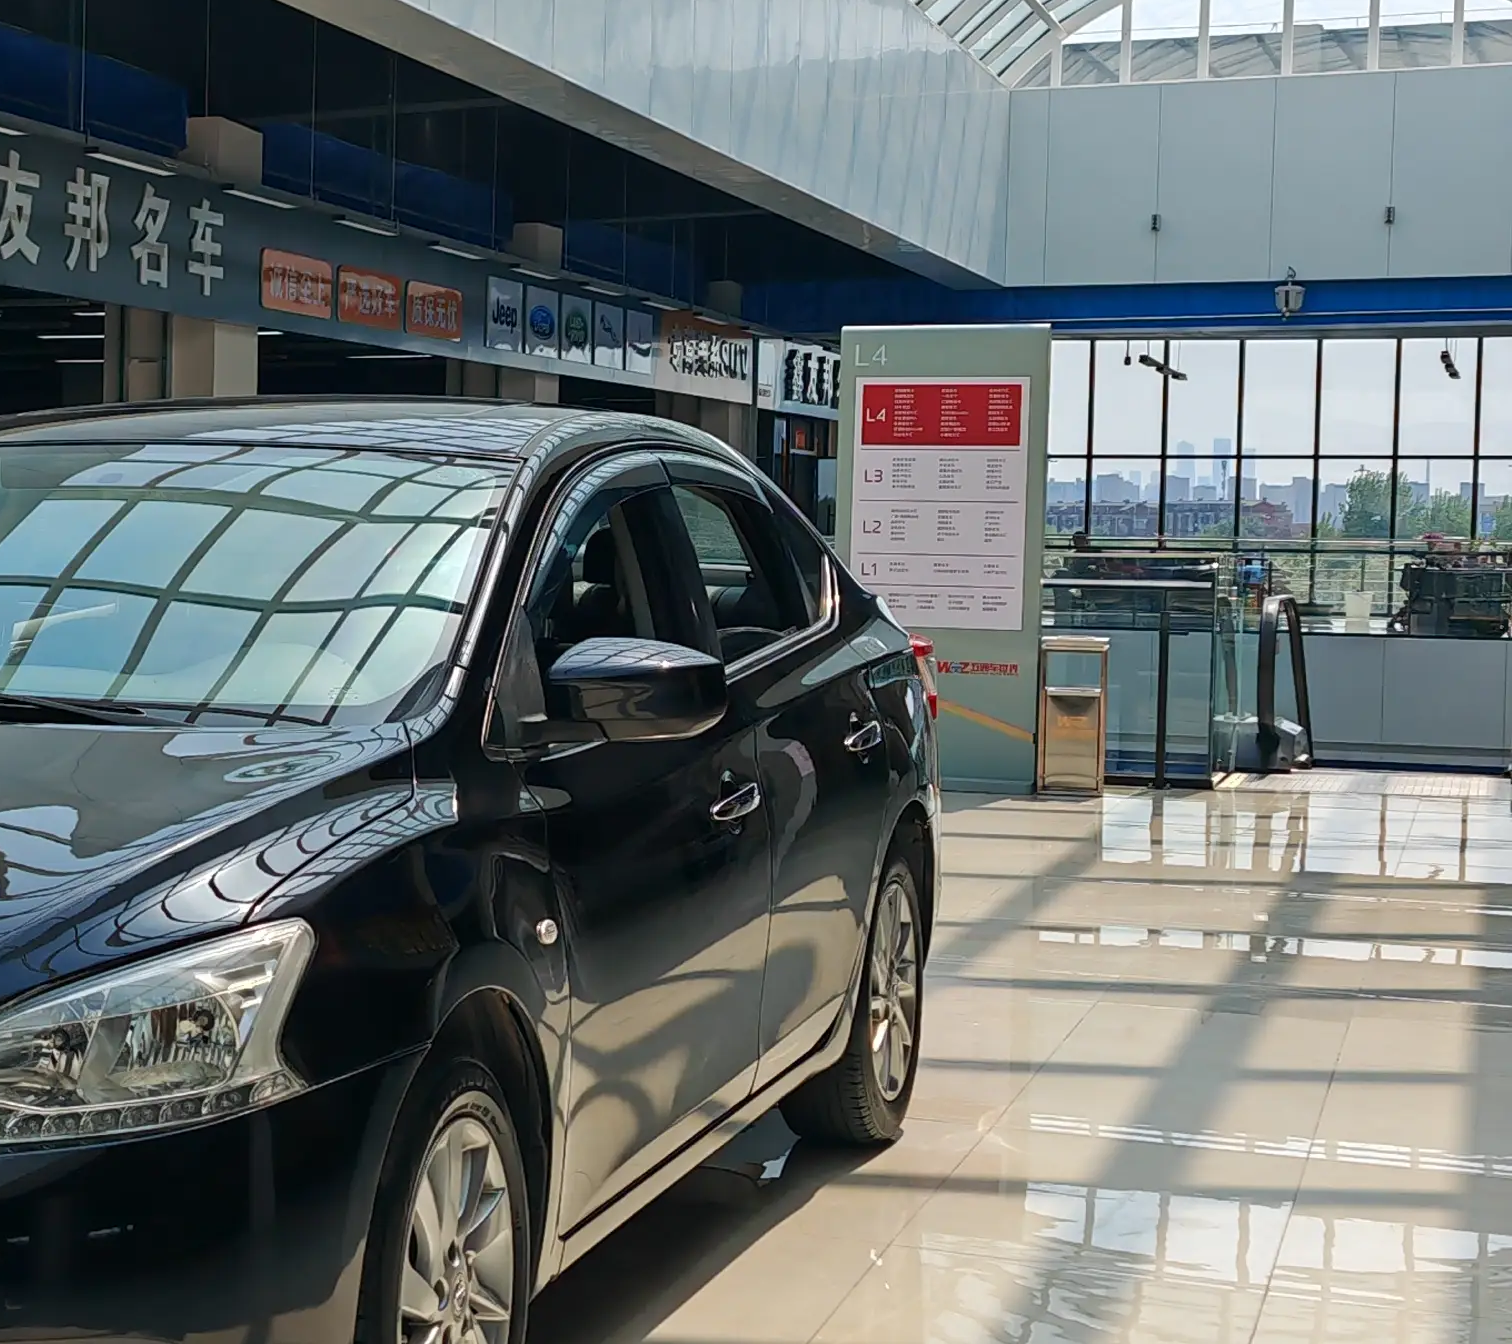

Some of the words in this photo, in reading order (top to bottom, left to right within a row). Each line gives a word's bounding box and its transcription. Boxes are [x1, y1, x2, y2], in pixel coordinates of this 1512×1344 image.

[492, 297, 518, 334] Jeep
[855, 344, 888, 366] L4
[784, 348, 841, 410] 鑫友邦
[866, 408, 887, 422] L4
[864, 469, 884, 483] L3
[863, 520, 882, 534] L2
[861, 562, 877, 576] L1
